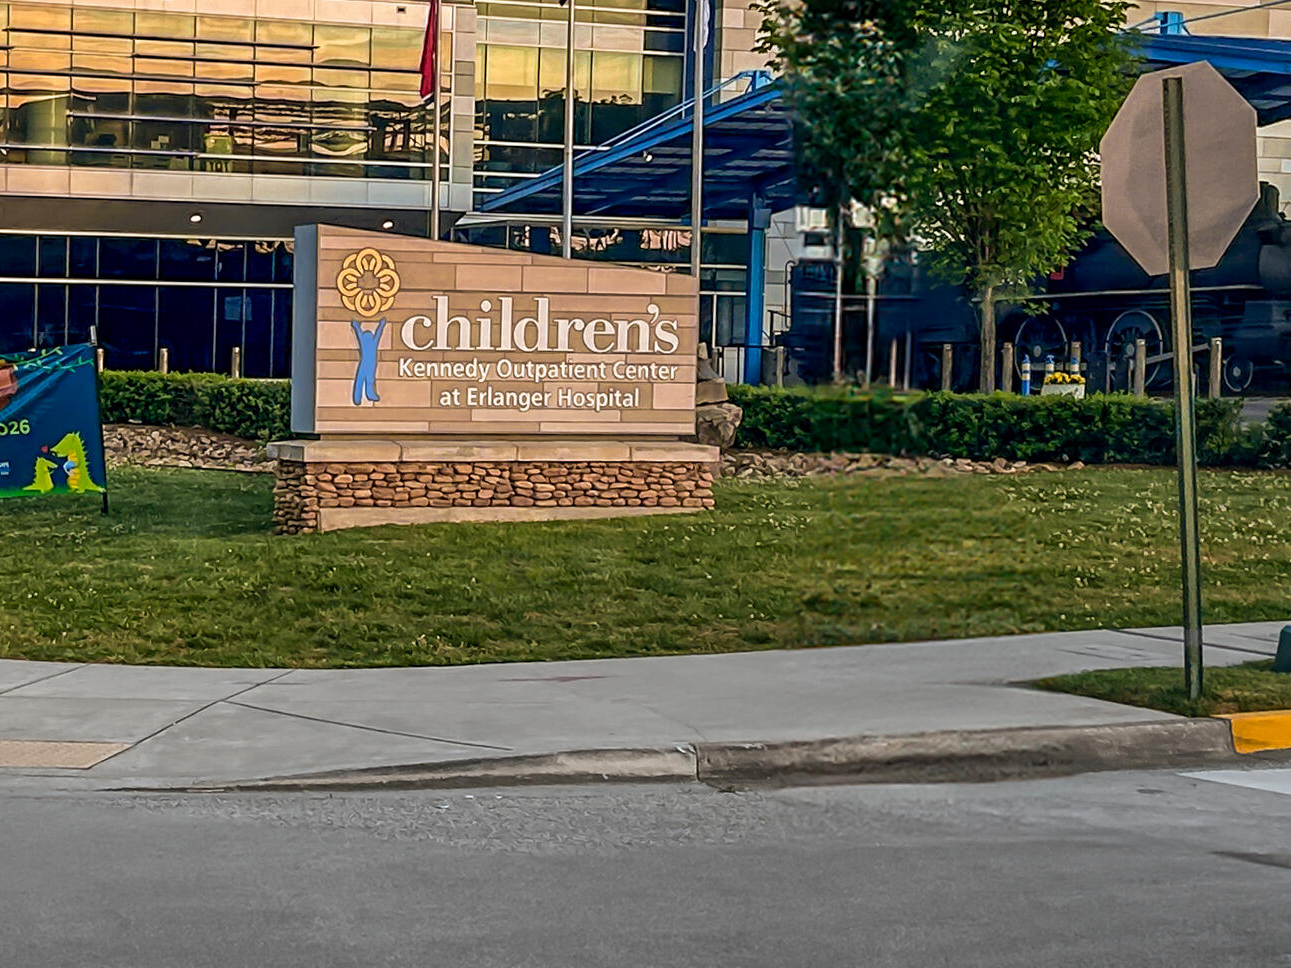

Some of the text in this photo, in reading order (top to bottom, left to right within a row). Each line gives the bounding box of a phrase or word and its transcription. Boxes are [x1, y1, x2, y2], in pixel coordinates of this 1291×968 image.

[399, 295, 680, 355] children's
[398, 358, 678, 384] Kennedy Outpatient Center
[439, 387, 640, 412] at Erlanger Hospital
